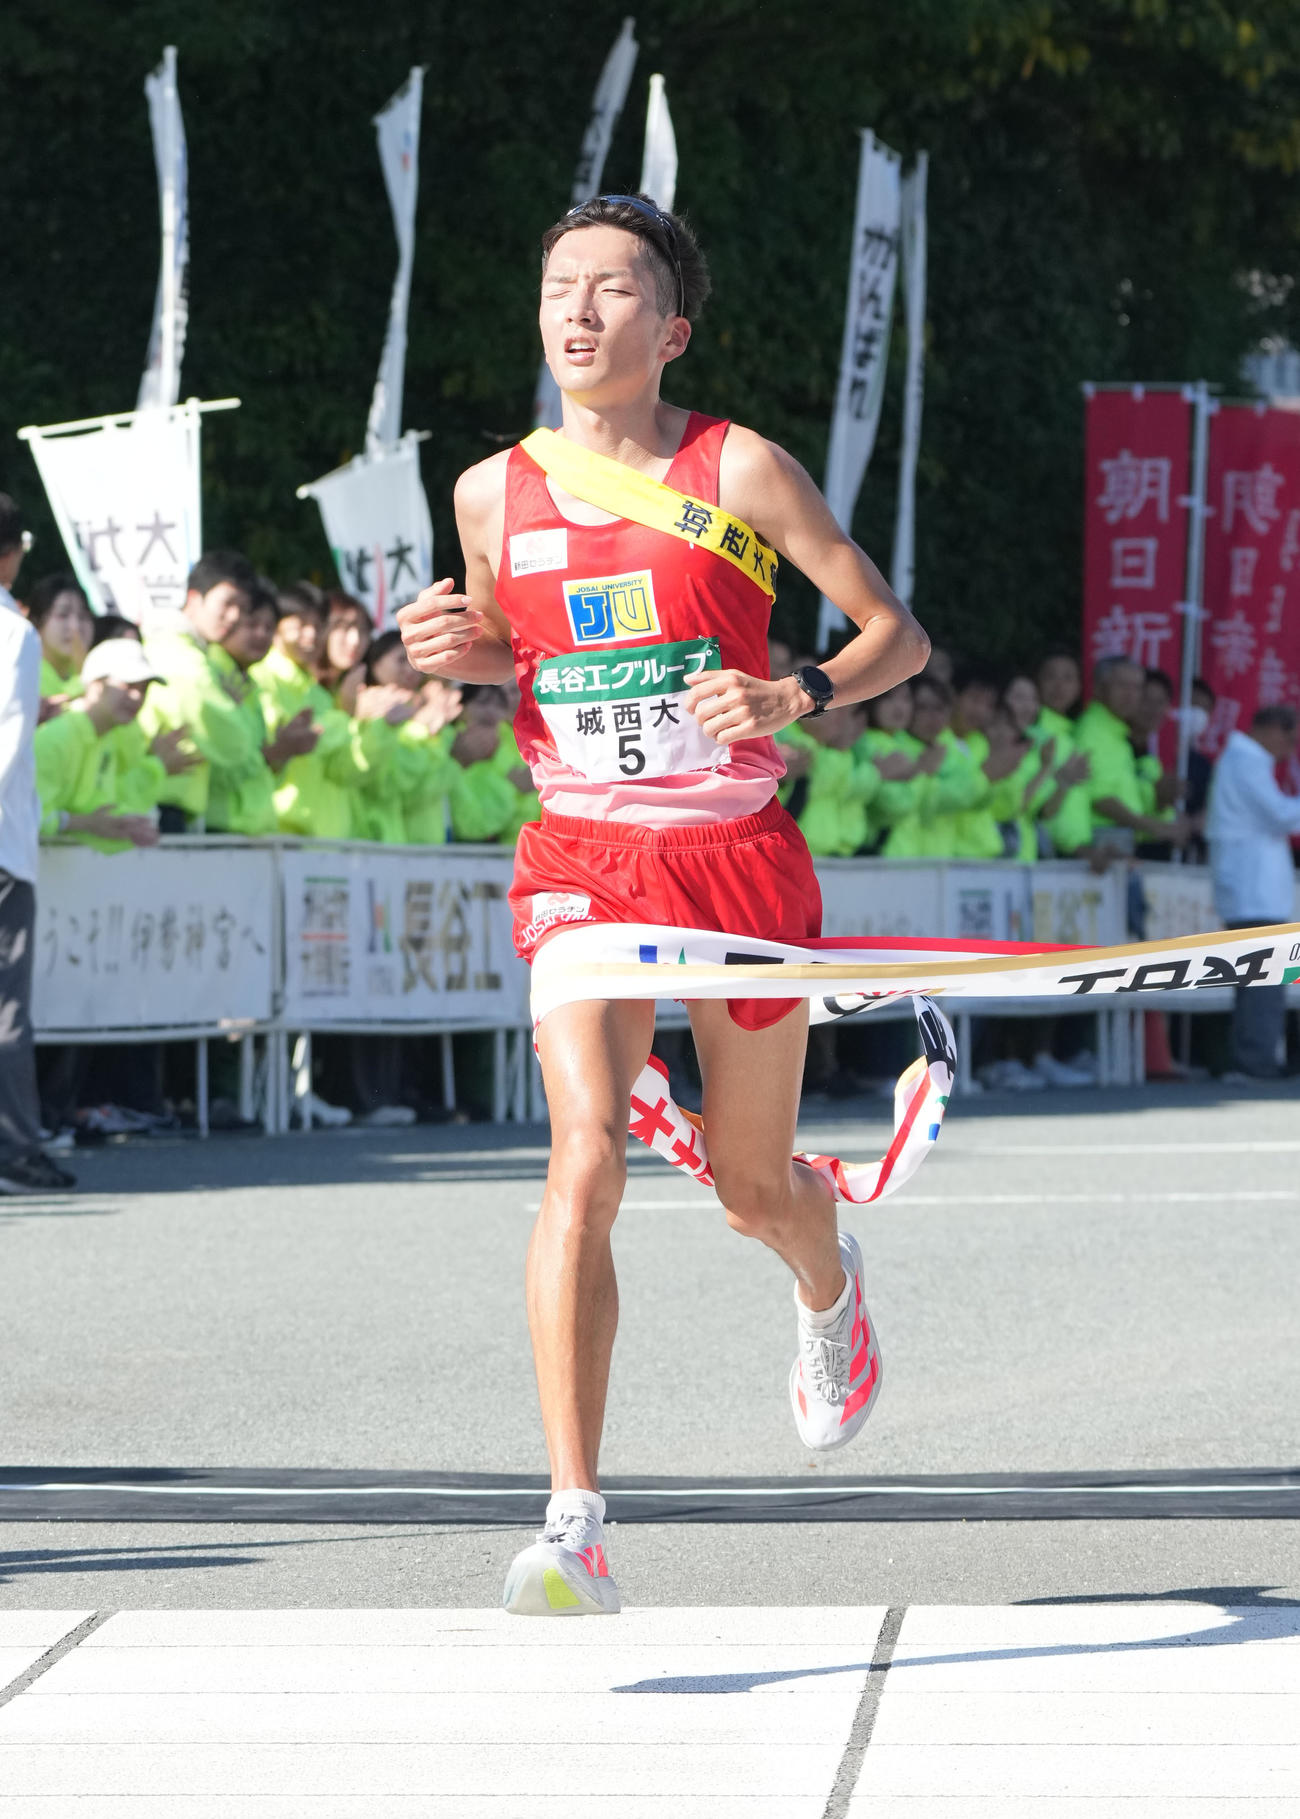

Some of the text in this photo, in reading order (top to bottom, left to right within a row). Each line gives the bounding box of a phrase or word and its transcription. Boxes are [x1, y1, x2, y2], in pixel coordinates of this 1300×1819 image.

[576, 578, 643, 594] JOSAI UNIVERSITY
[579, 586, 652, 640] JU
[537, 649, 713, 695] 長谷工グループ
[575, 698, 681, 736] 城西大
[618, 733, 646, 776] 5
